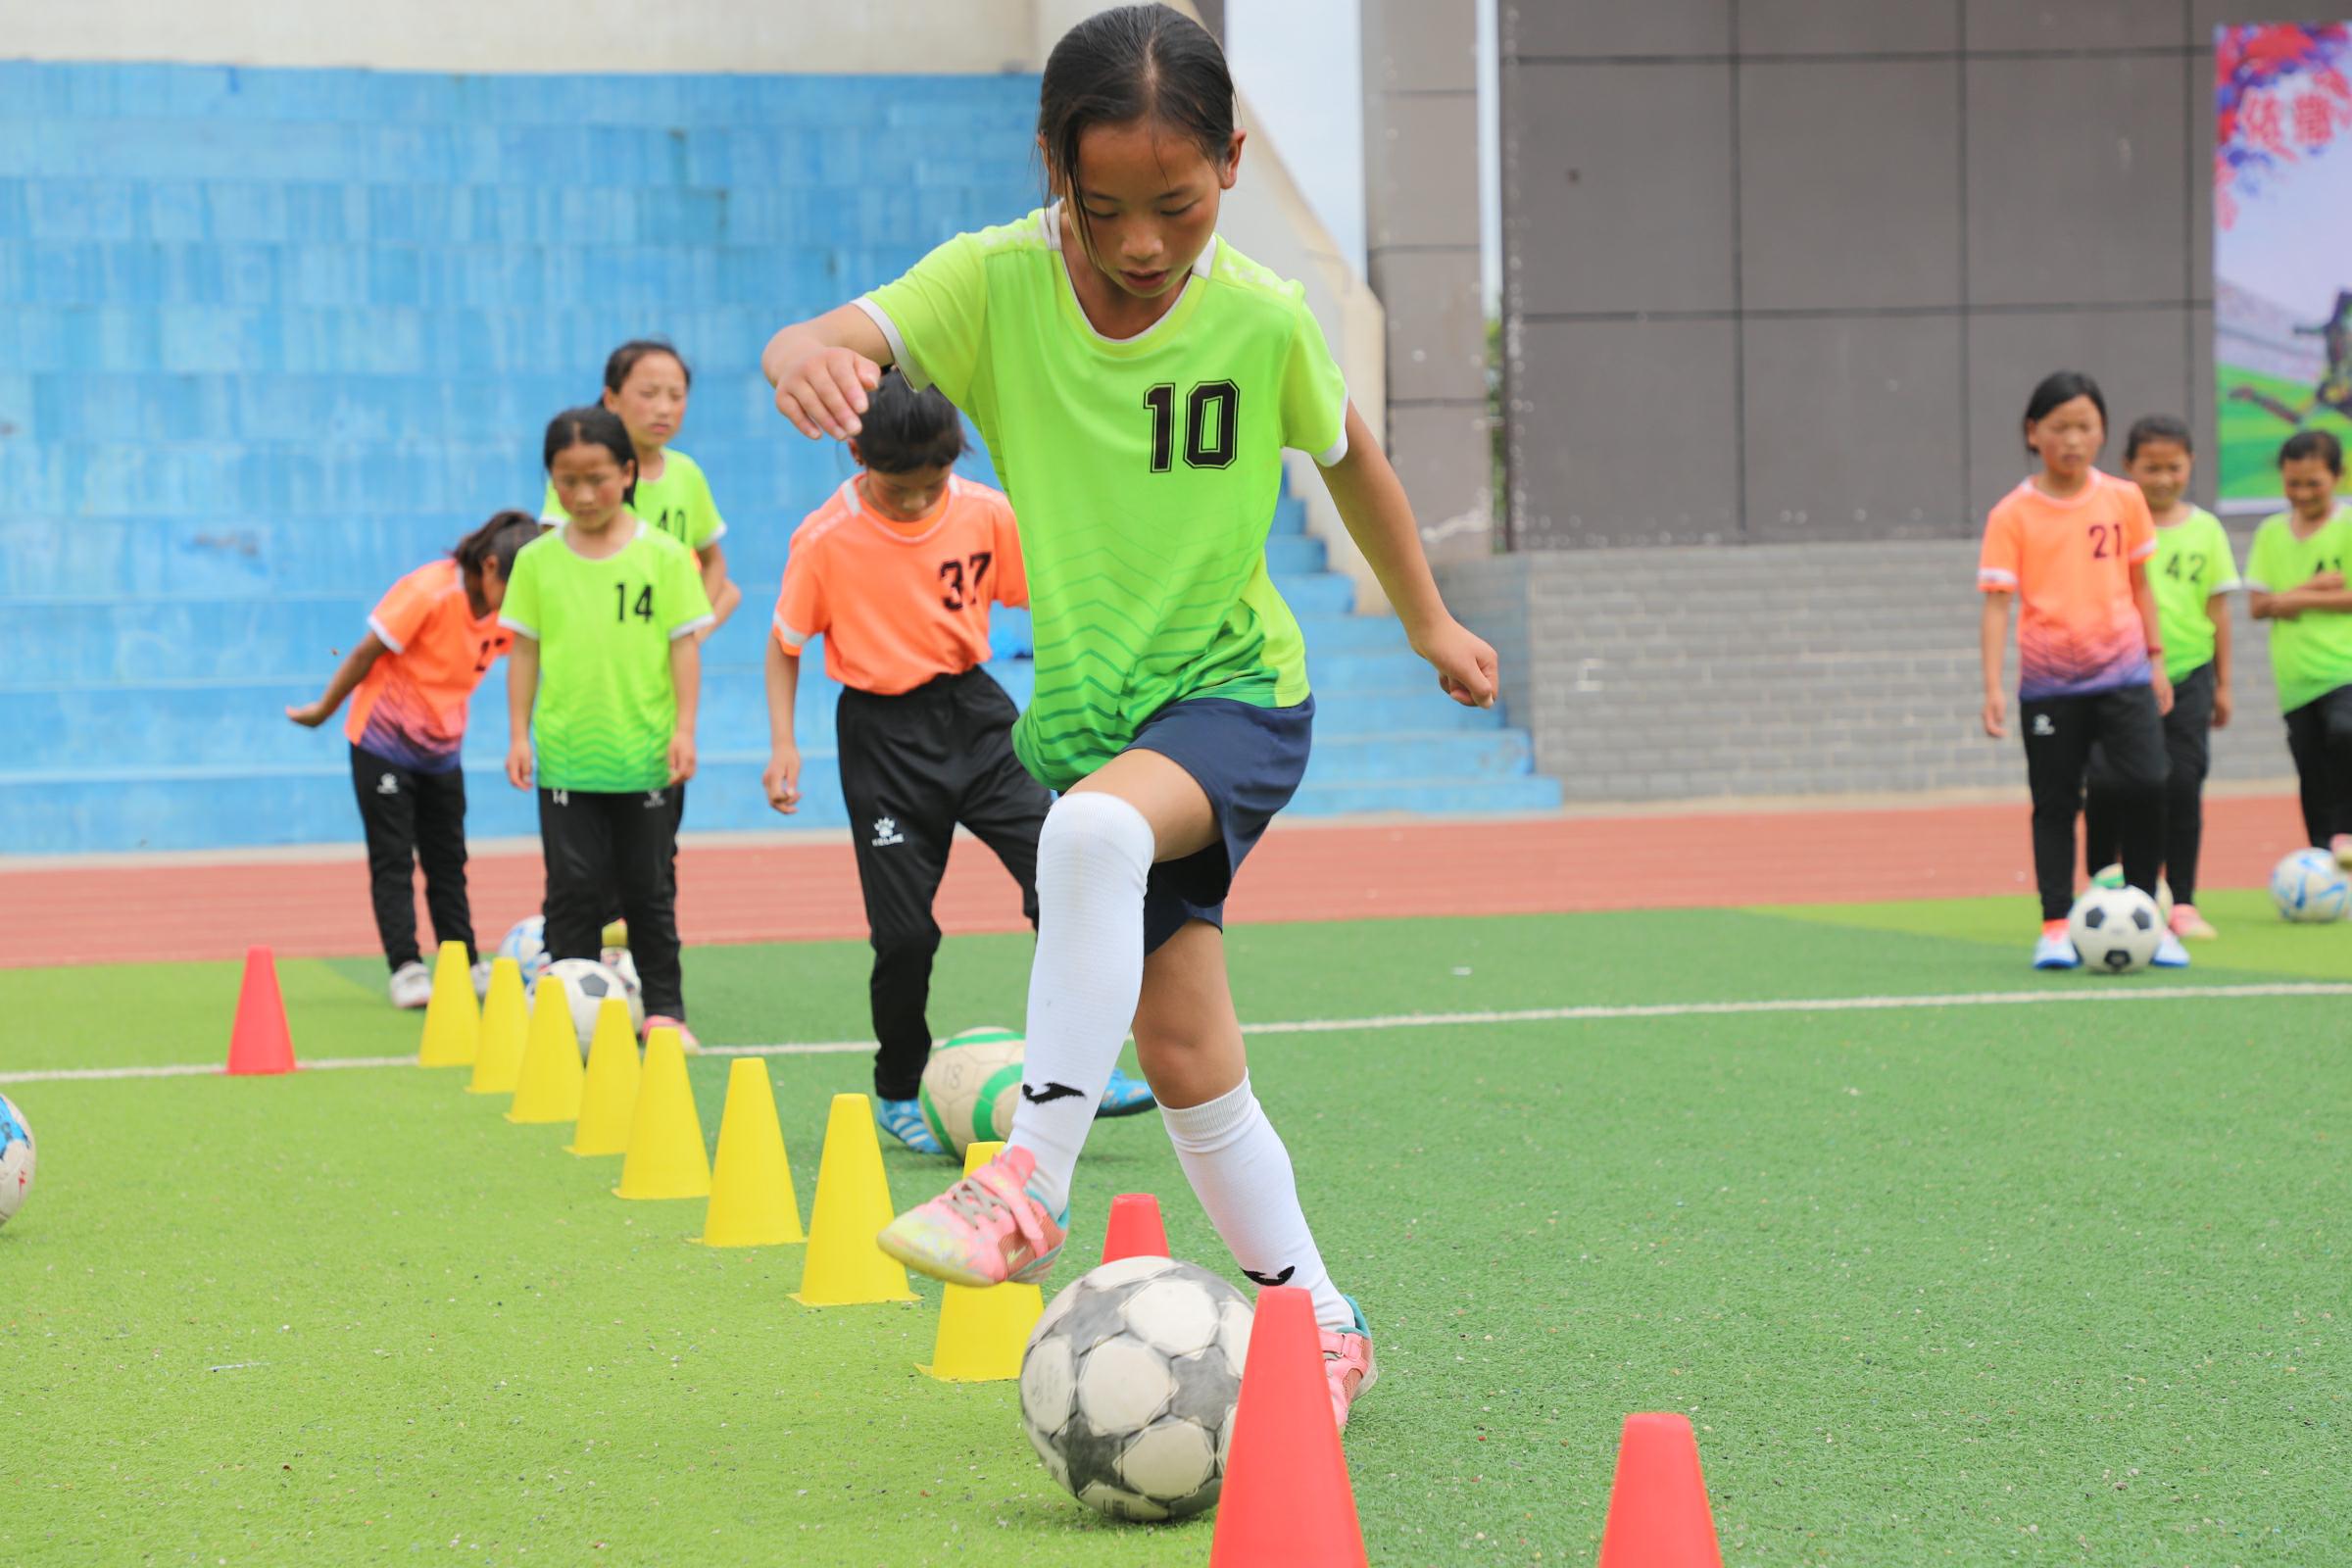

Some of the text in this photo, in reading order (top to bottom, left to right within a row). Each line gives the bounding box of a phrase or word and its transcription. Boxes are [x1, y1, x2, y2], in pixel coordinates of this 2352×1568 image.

[1143, 379, 1240, 473] 10
[2088, 523, 2122, 559] 21
[940, 551, 992, 612] 37
[2166, 553, 2208, 584] 42
[614, 582, 654, 623] 14
